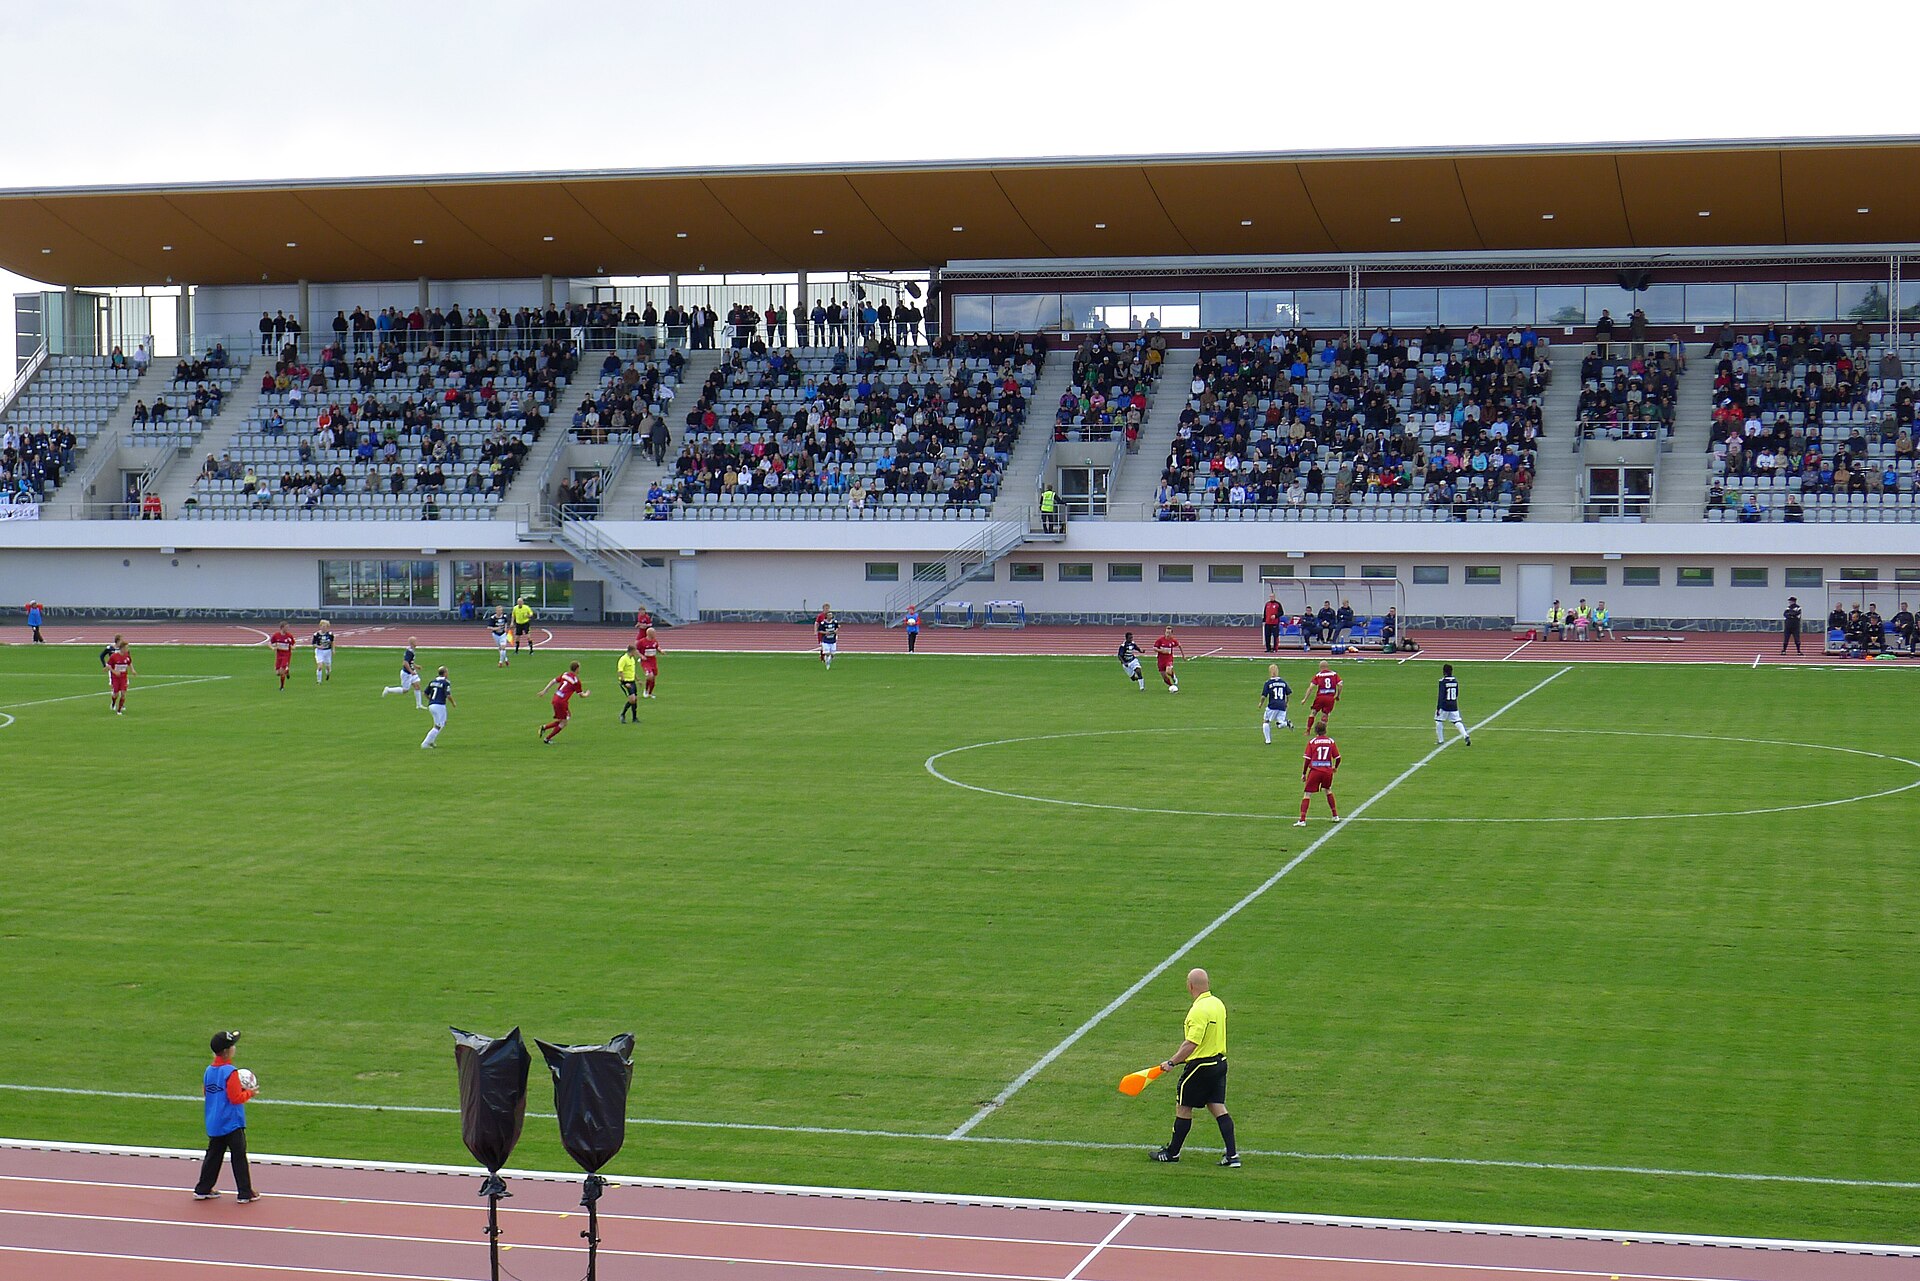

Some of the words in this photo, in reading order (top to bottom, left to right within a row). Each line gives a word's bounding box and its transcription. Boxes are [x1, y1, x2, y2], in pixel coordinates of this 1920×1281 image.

[1325, 678, 1331, 688] 8
[1273, 687, 1283, 699] 14
[1317, 746, 1329, 760] 17
